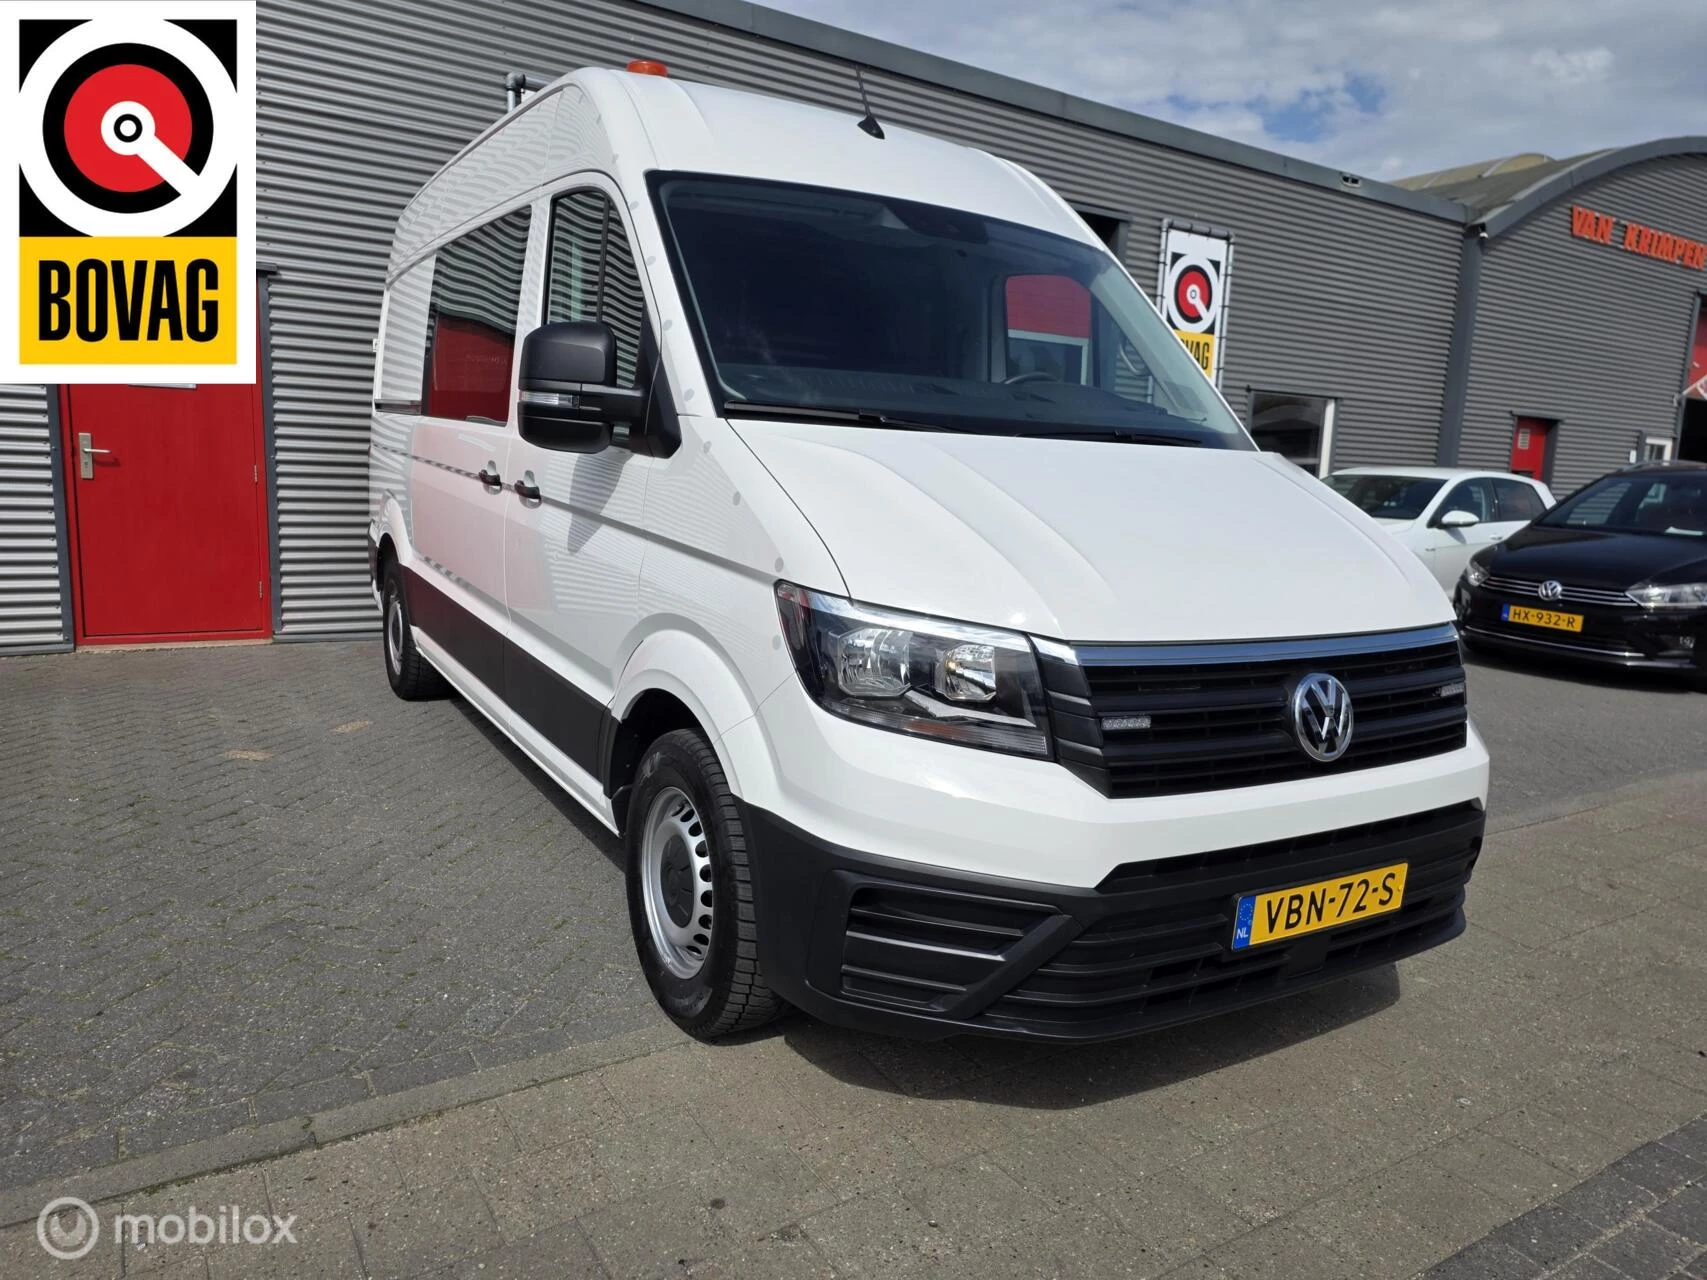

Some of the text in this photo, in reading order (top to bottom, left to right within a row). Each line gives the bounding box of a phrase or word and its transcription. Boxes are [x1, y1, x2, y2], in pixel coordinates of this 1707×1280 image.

[1571, 205, 1707, 270] VAN KRIMPEN
[1513, 608, 1576, 628] HX-932-R
[1295, 674, 1352, 761] VW
[1236, 872, 1396, 939] NL VBN-72-S
